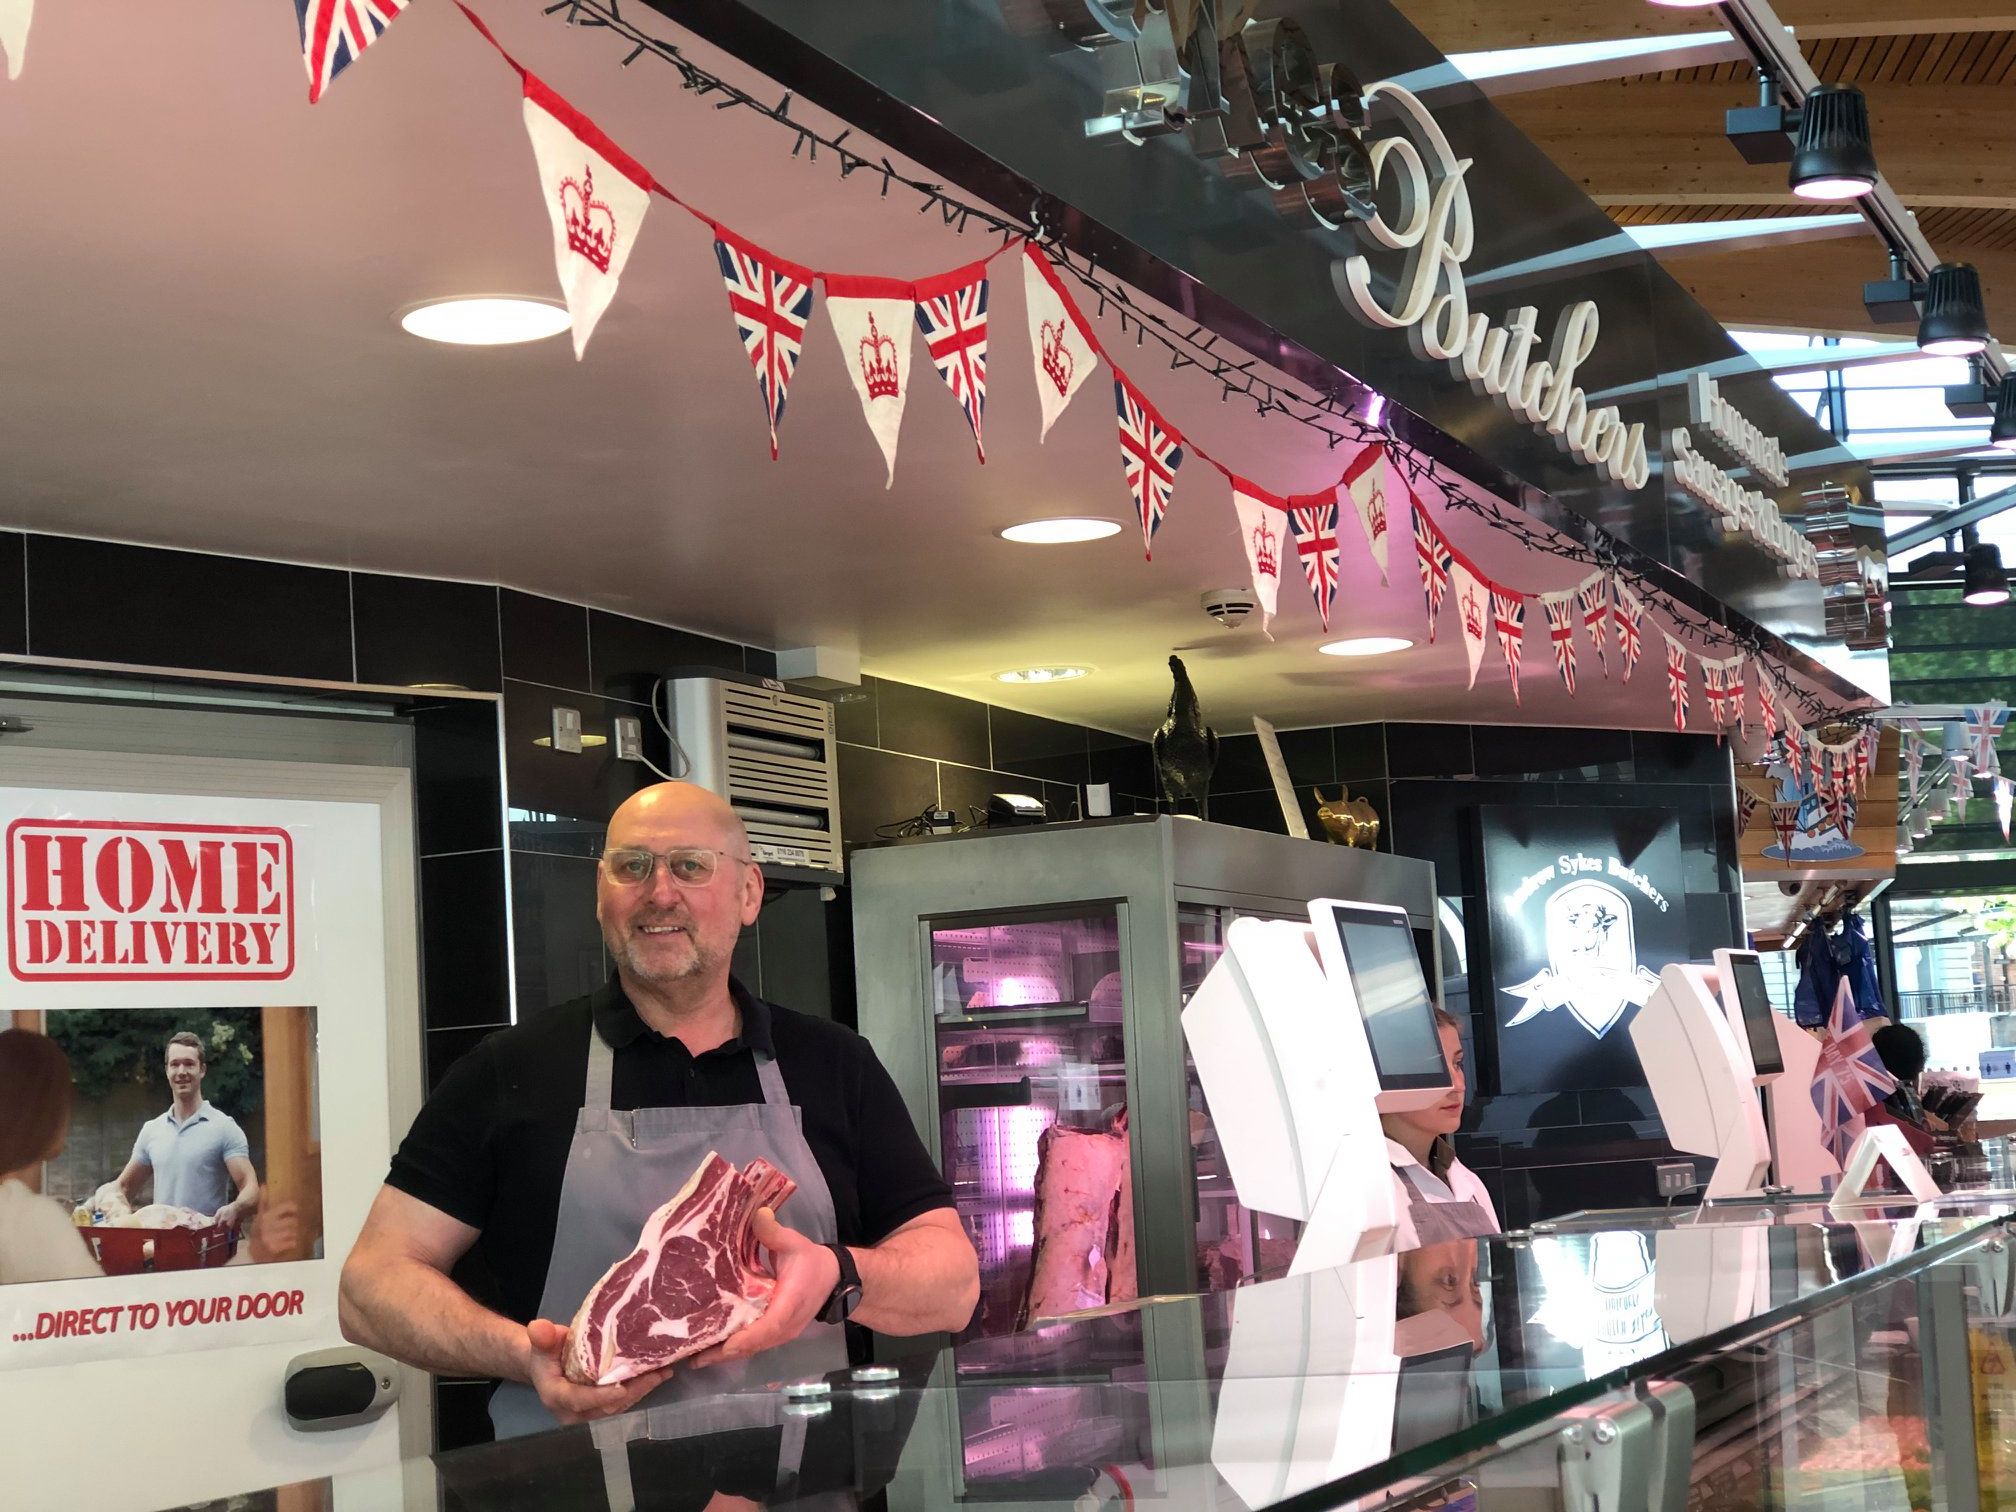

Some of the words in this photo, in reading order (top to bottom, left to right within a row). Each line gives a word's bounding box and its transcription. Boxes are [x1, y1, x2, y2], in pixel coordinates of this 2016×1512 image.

[1346, 82, 1650, 491] Butchers
[1696, 372, 1790, 487] Homemade
[20, 834, 282, 915] HOME
[1558, 853, 1602, 876] Sykes
[1608, 856, 1670, 913] Butchers
[25, 919, 281, 966] DELIVERY
[128, 1302, 160, 1331] TO
[166, 1297, 231, 1327] YOUR
[236, 1289, 305, 1321] DOOR
